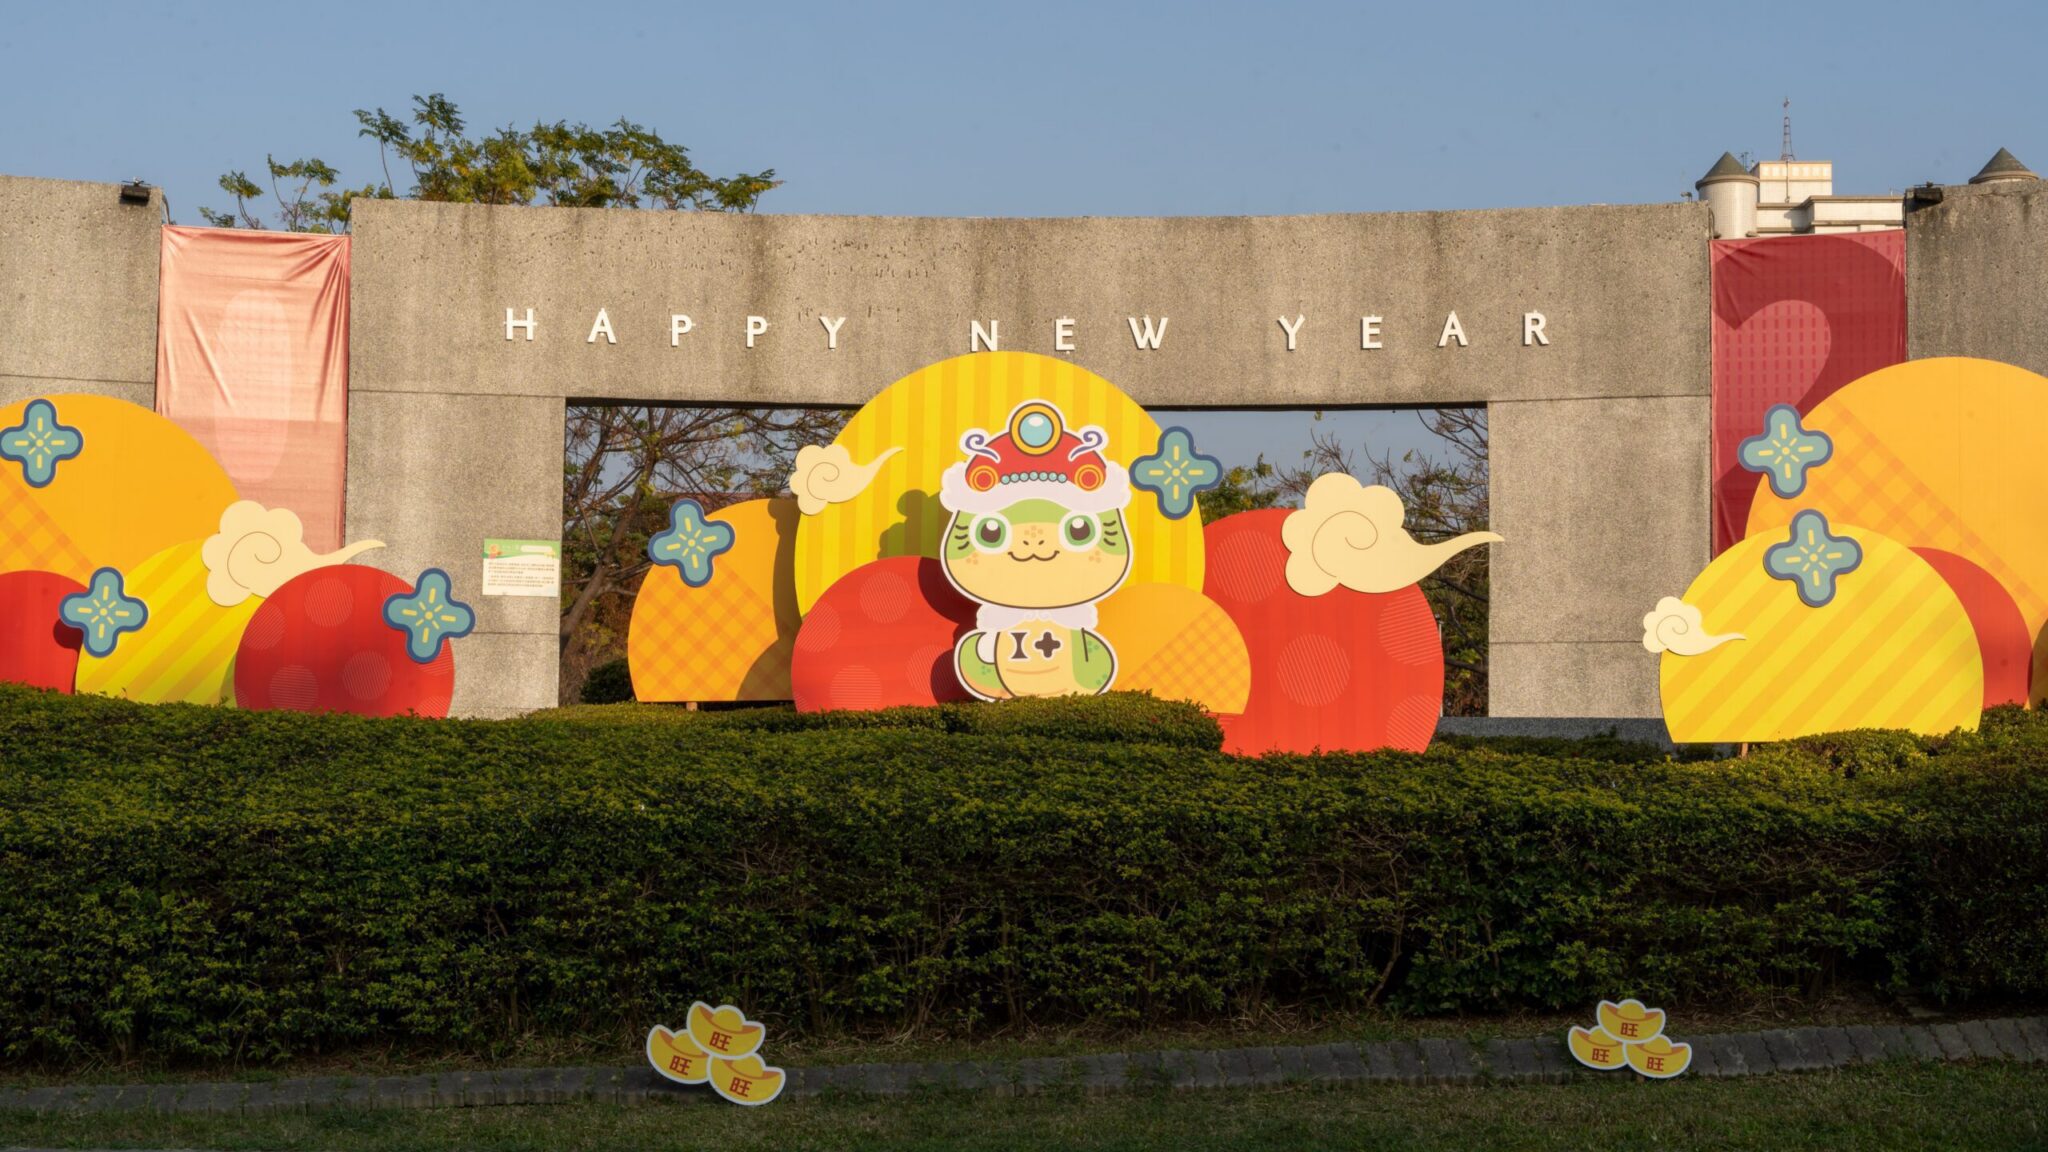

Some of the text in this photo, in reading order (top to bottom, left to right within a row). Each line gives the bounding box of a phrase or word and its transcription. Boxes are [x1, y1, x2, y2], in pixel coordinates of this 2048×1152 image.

[505, 307, 1550, 352] HAPPY NEW YEAR
[1620, 1022, 1639, 1038] 旺
[709, 1031, 733, 1052] 旺
[669, 1055, 692, 1076] 旺
[1591, 1048, 1610, 1063] 旺
[1646, 1056, 1665, 1072] 旺
[729, 1077, 752, 1098] 旺
